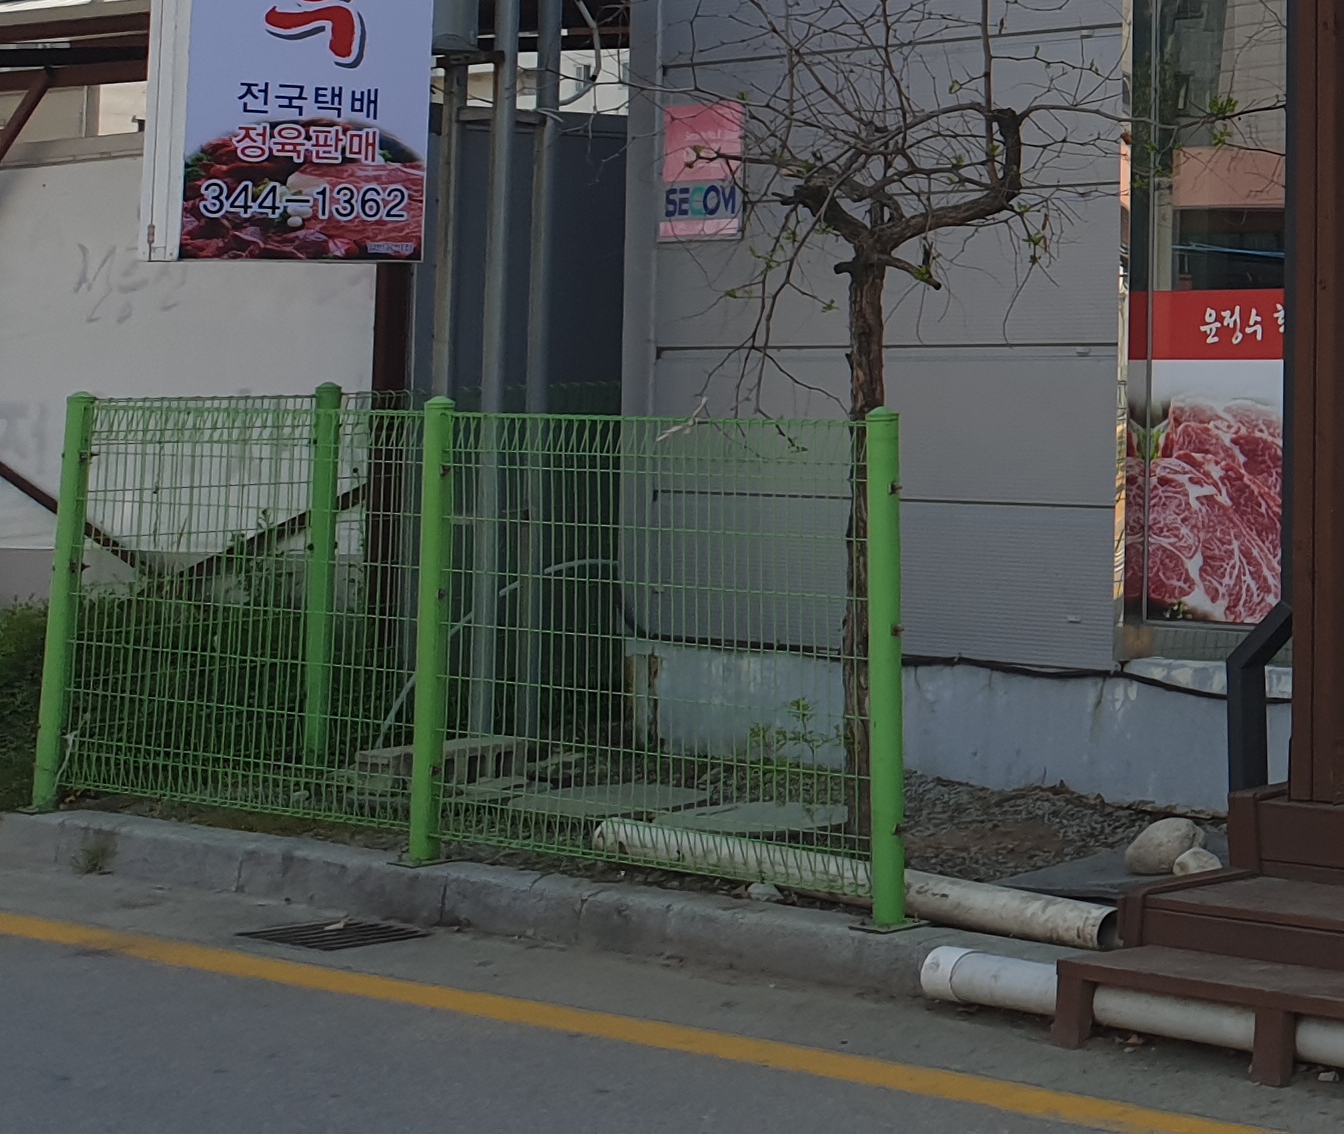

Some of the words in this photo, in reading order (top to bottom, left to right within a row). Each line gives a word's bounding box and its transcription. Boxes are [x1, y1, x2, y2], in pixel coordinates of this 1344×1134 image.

[237, 81, 379, 120] 전국택배
[234, 123, 379, 163] 정육판매
[201, 181, 406, 220] 344-1362
[1200, 305, 1264, 344] 윤정수
